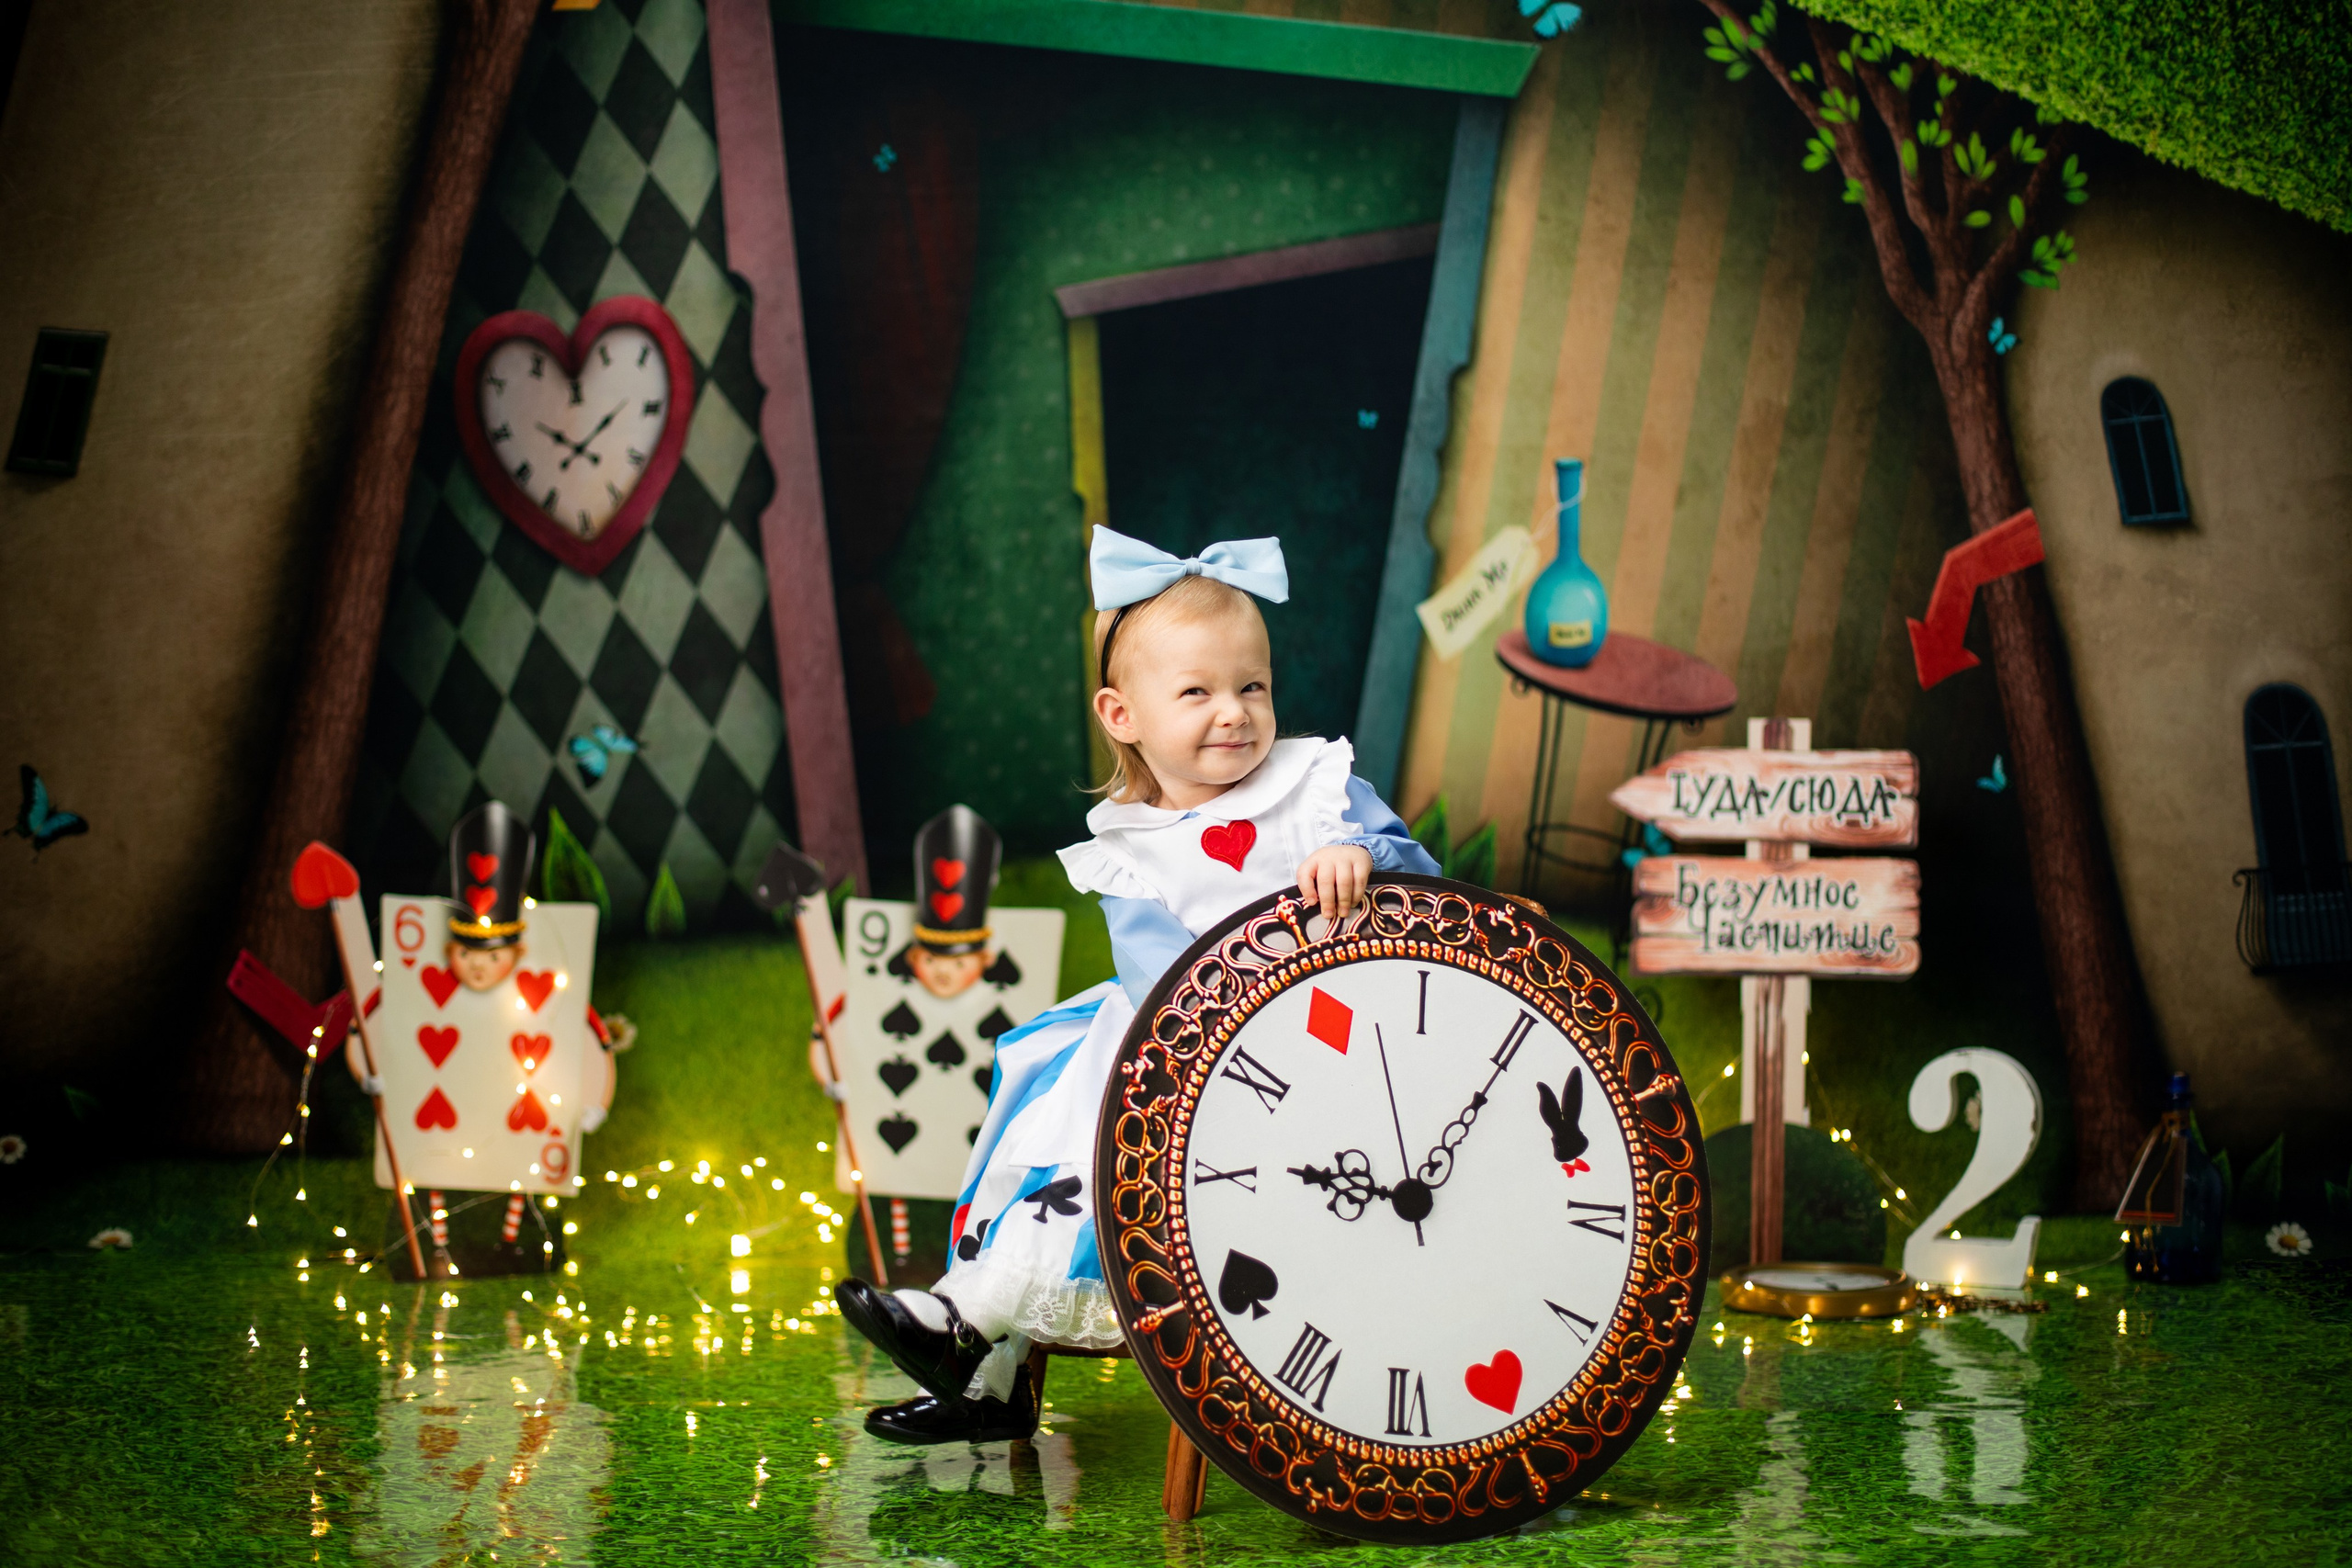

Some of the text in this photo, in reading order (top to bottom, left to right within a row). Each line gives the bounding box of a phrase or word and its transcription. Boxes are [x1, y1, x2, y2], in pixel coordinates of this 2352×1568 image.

[1668, 773, 1898, 825] ТУДА/СЮДА
[394, 903, 425, 953] 6
[858, 909, 891, 959] 9
[1220, 1044, 1291, 1114] XI
[1194, 1158, 1258, 1194] X
[1903, 1046, 2041, 1289] 2
[1567, 1199, 1626, 1244] IV
[1273, 1321, 1344, 1413] VIII
[1384, 1367, 1433, 1438] VII
